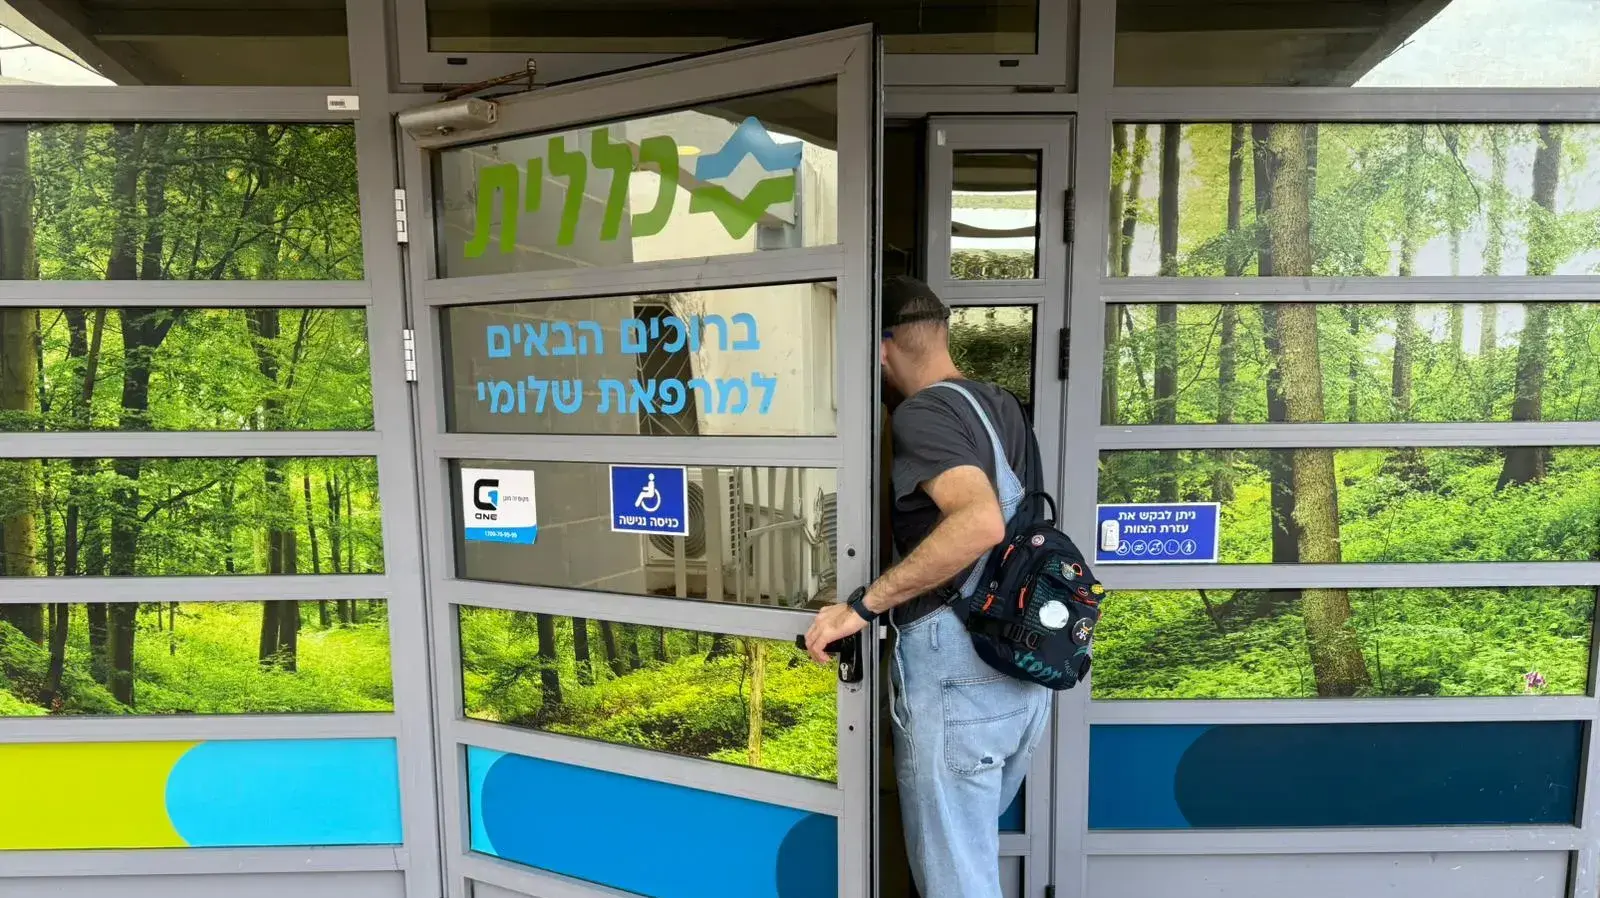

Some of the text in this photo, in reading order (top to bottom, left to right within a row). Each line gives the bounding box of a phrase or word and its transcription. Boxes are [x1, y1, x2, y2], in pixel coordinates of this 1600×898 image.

[464, 128, 679, 258] כללית
[487, 312, 760, 358] ברוכים הבאים
[477, 371, 777, 414] למרפאת שלומי
[474, 512, 498, 521] ONE
[619, 515, 679, 528] כניסה נגישה
[1118, 510, 1196, 522] ניתן לבקש את
[1123, 524, 1189, 534] עזרת הצוות
